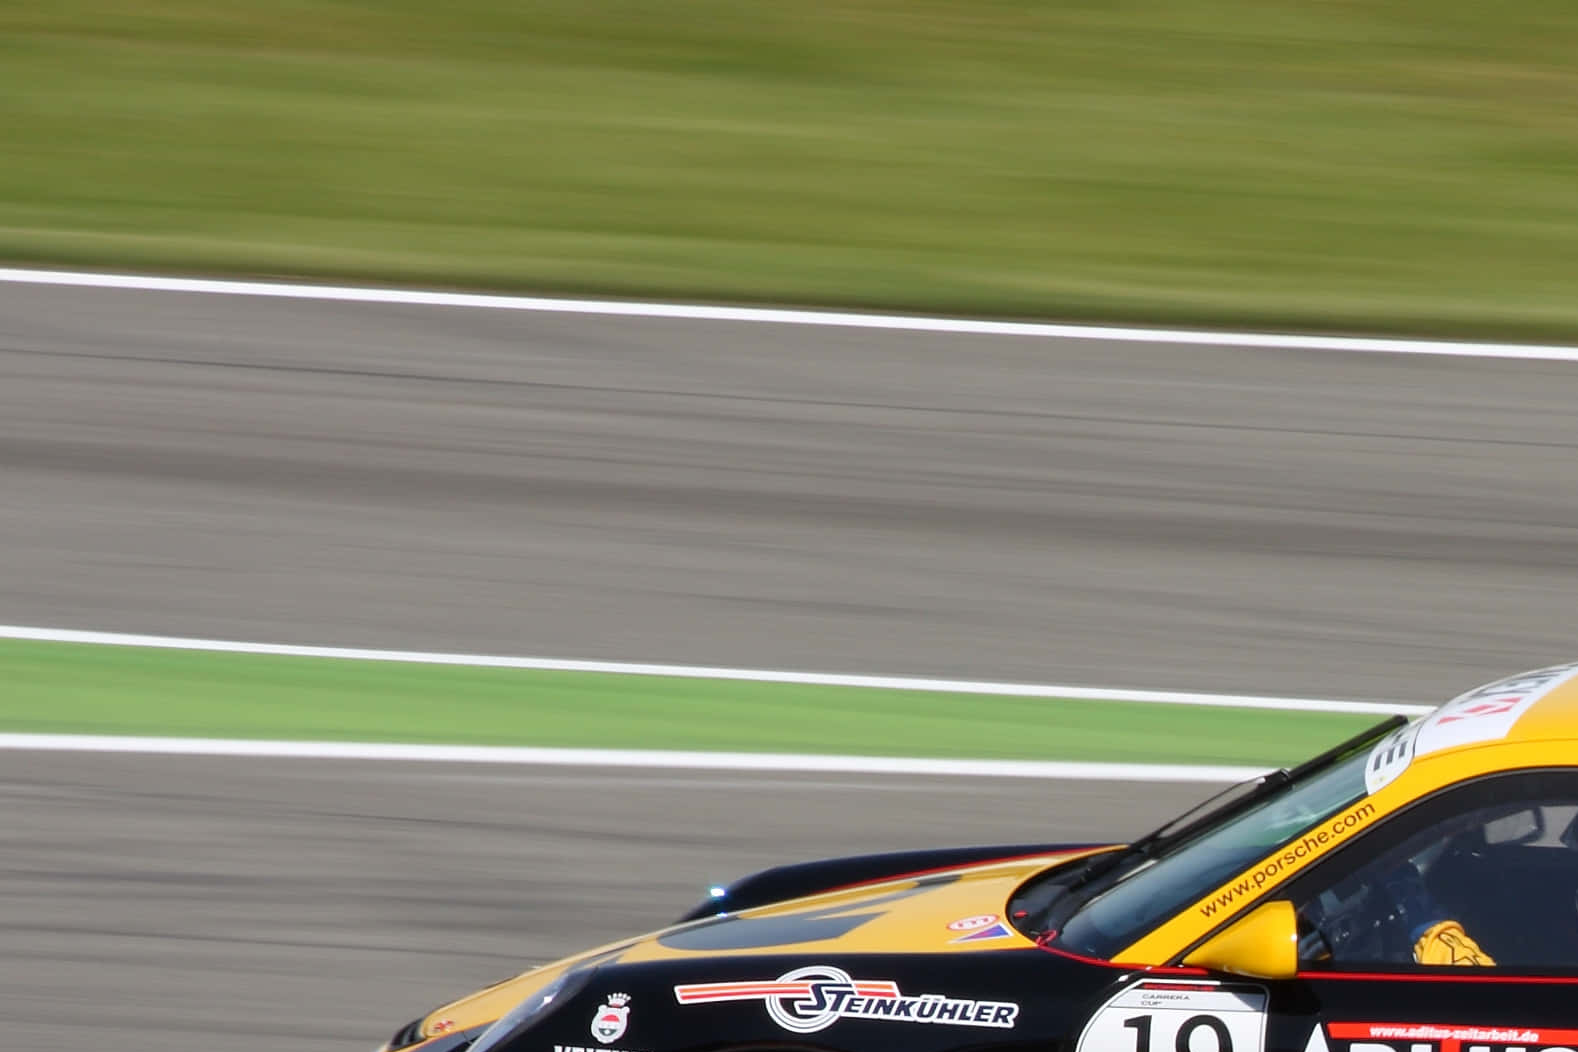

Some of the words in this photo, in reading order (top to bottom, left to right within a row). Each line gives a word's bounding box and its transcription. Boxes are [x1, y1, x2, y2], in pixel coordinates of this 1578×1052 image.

[1200, 803, 1376, 918] www.porsche.com
[795, 982, 1017, 1028] STEINKÜHLER
[1369, 1025, 1540, 1043] www.aditus-zeitarbeit.de
